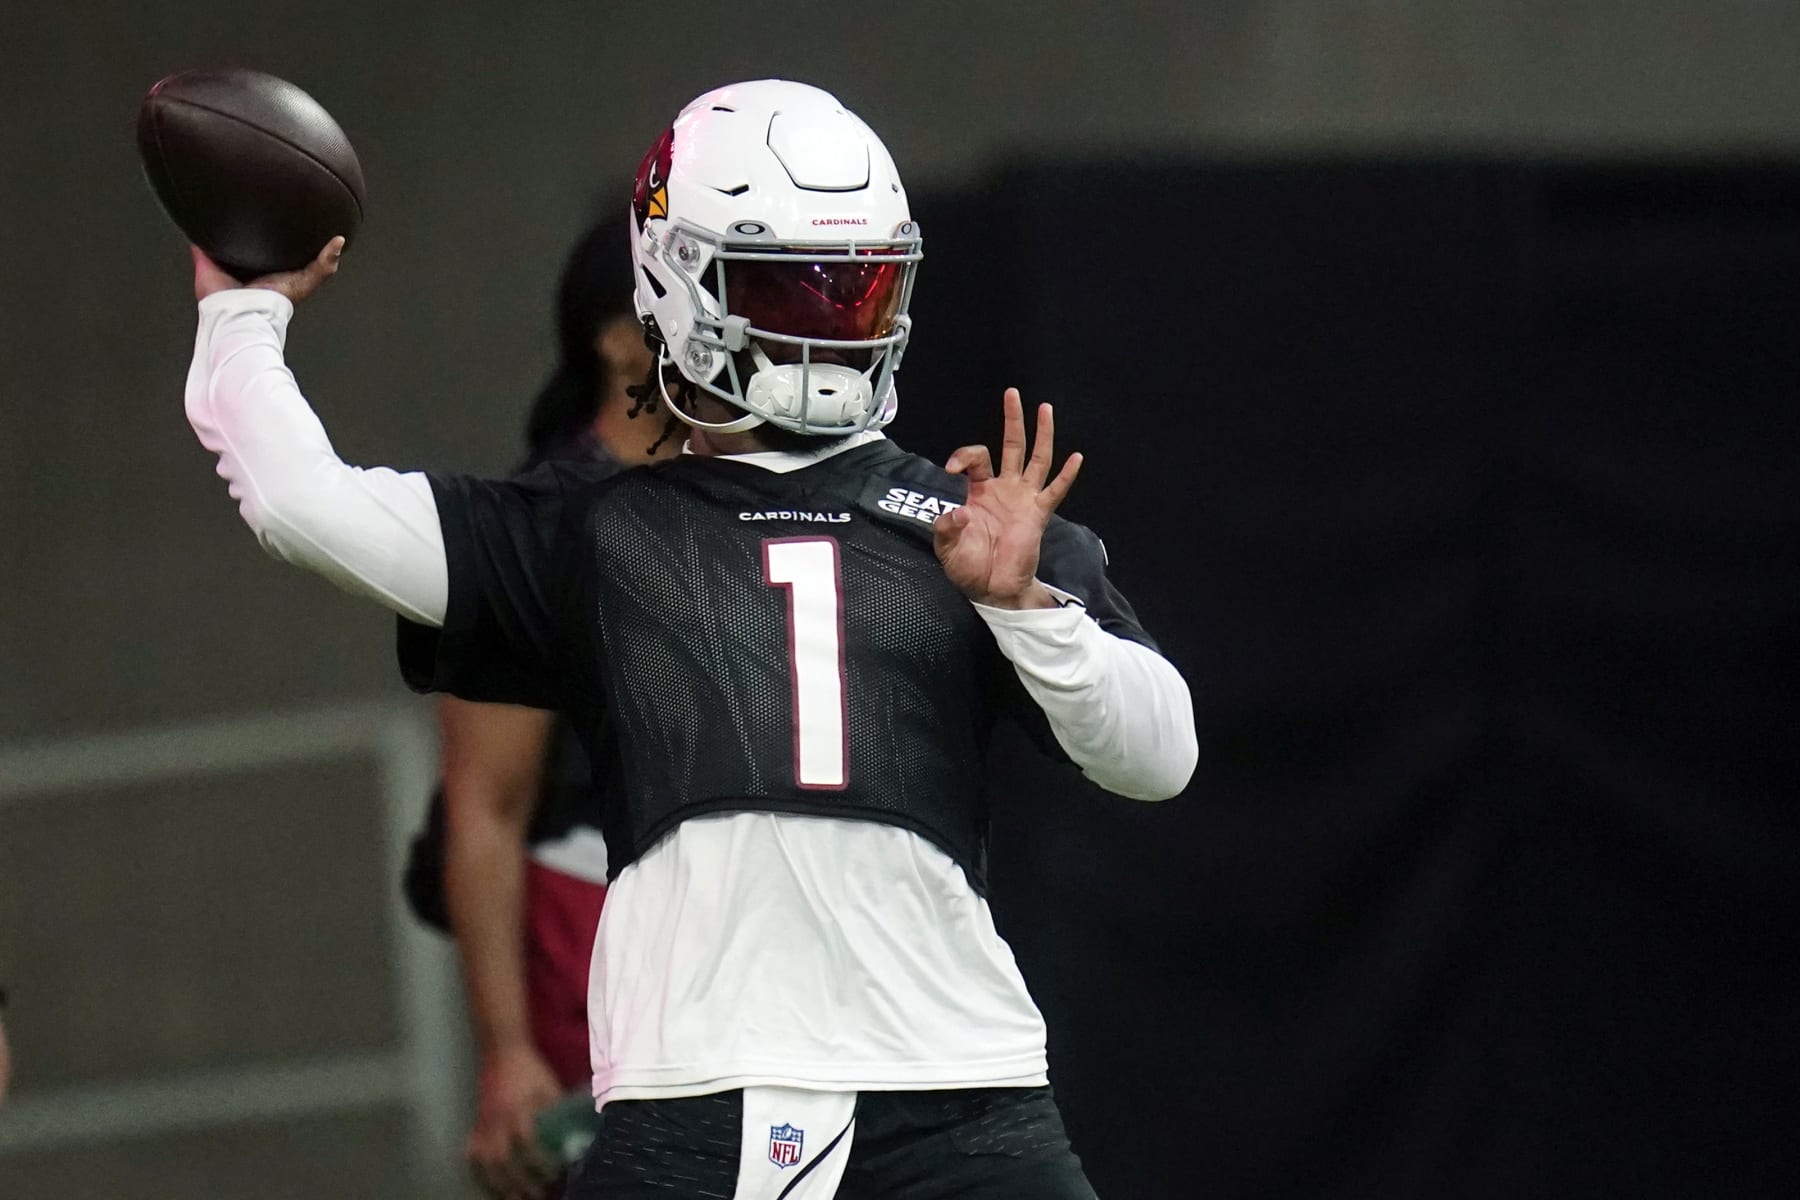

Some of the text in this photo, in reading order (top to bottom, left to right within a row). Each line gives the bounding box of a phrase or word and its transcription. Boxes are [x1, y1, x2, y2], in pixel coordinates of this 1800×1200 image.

[812, 218, 868, 226] CARDINALS
[877, 499, 940, 525] GEE
[886, 487, 961, 515] SEAT
[739, 511, 851, 523] CARDINALS
[762, 535, 848, 791] 1
[772, 1141, 799, 1164] NFL
